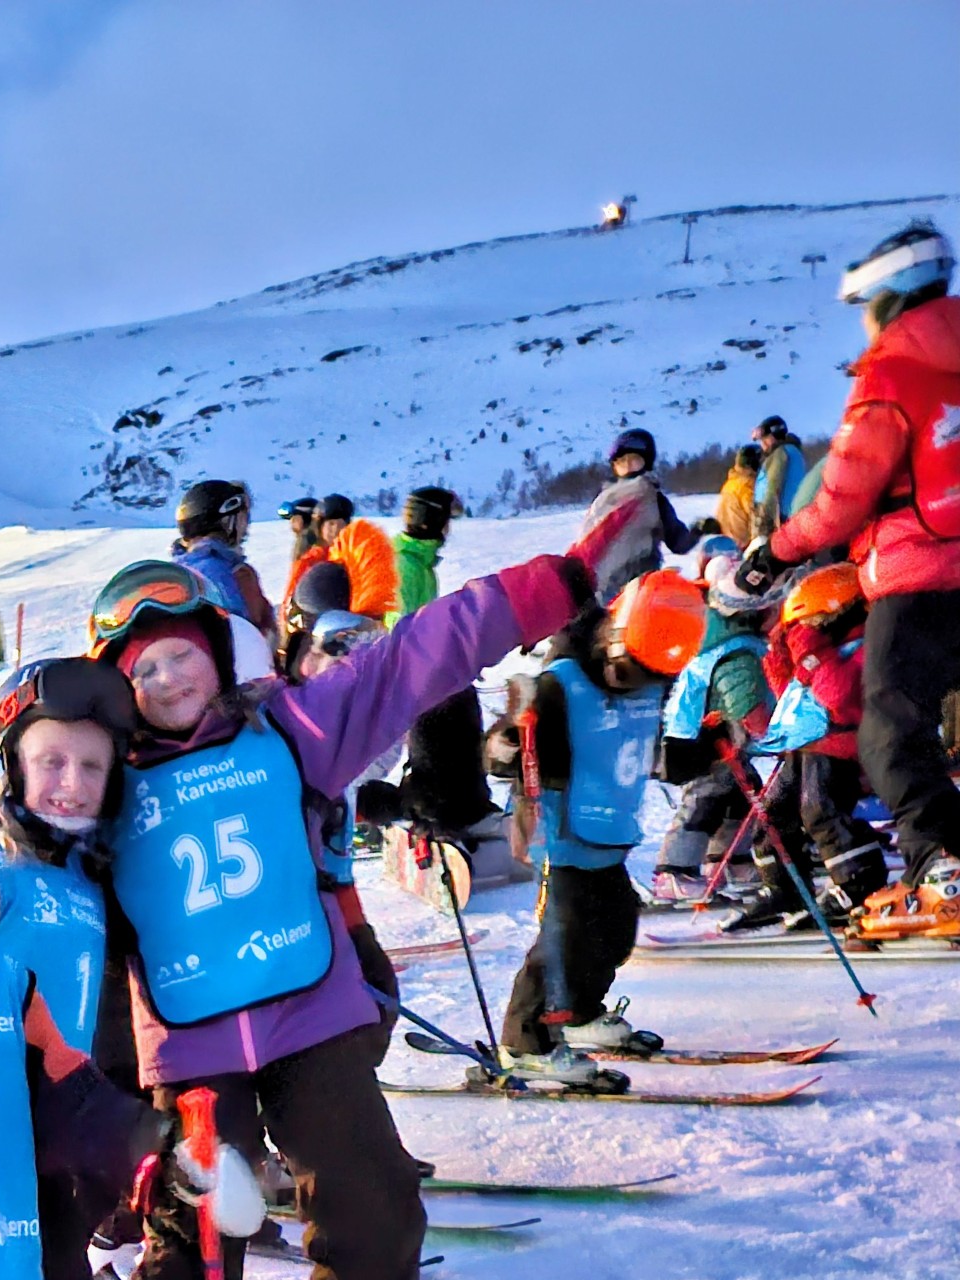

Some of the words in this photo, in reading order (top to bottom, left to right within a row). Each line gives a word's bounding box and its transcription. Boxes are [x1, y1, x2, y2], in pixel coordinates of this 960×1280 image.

[172, 757, 235, 785] Telenor
[175, 768, 268, 805] Karusellen
[169, 813, 263, 917] 25
